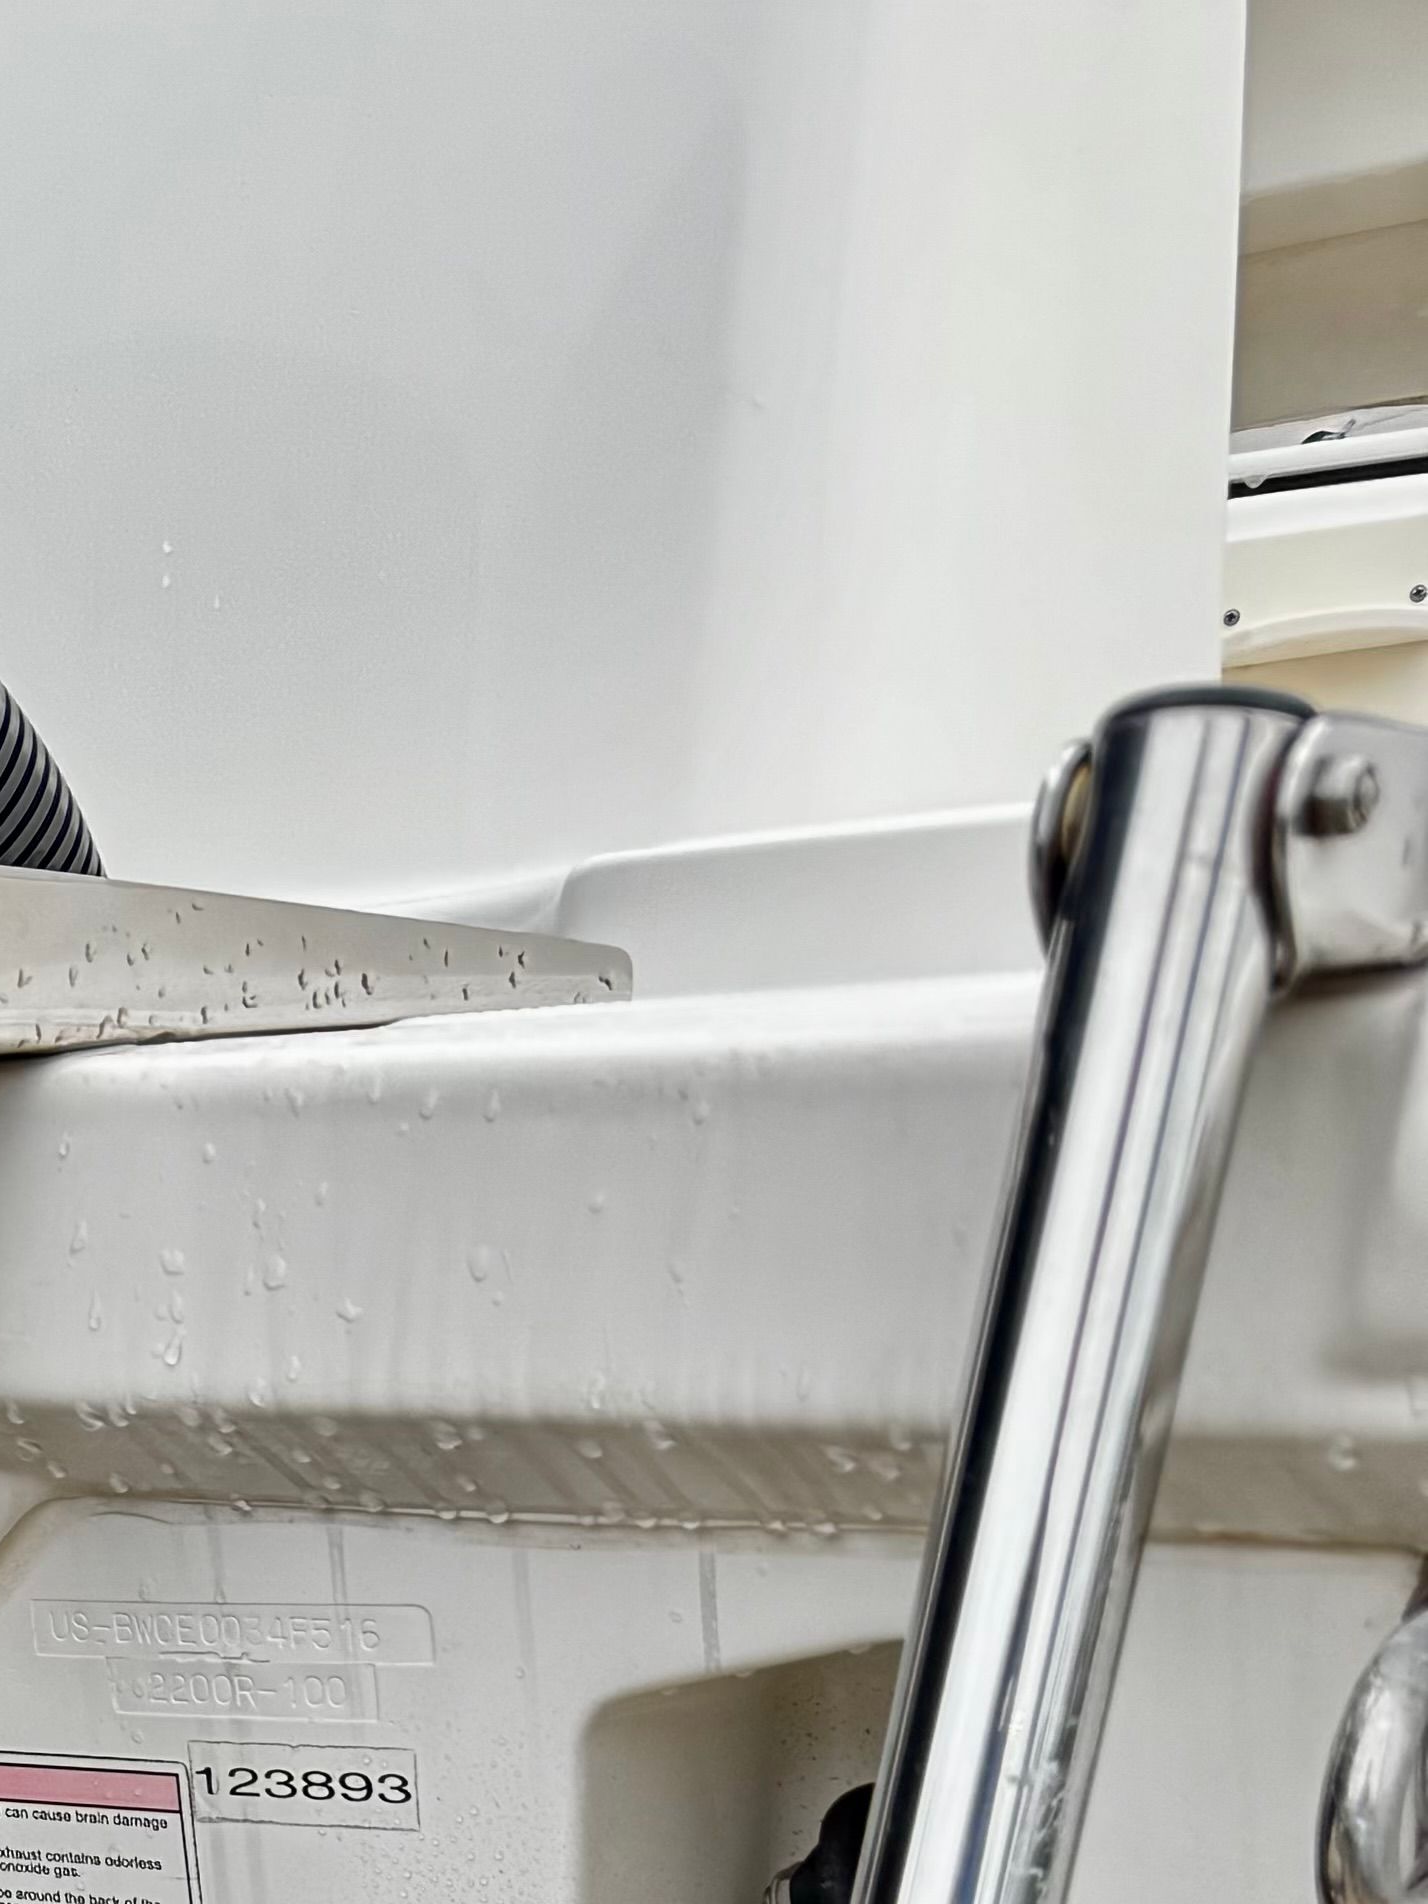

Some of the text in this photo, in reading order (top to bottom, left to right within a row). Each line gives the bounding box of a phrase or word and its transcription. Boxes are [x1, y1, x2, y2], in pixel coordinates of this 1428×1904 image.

[195, 1767, 413, 1804] 123893
[5, 1808, 29, 1819] can
[32, 1810, 71, 1822] cause
[75, 1810, 109, 1825] brain
[113, 1813, 168, 1831] damage
[45, 1852, 101, 1866] contains
[105, 1855, 162, 1871] odorless
[54, 1867, 81, 1879] gas.
[16, 1890, 61, 1903] around
[64, 1892, 85, 1904] the
